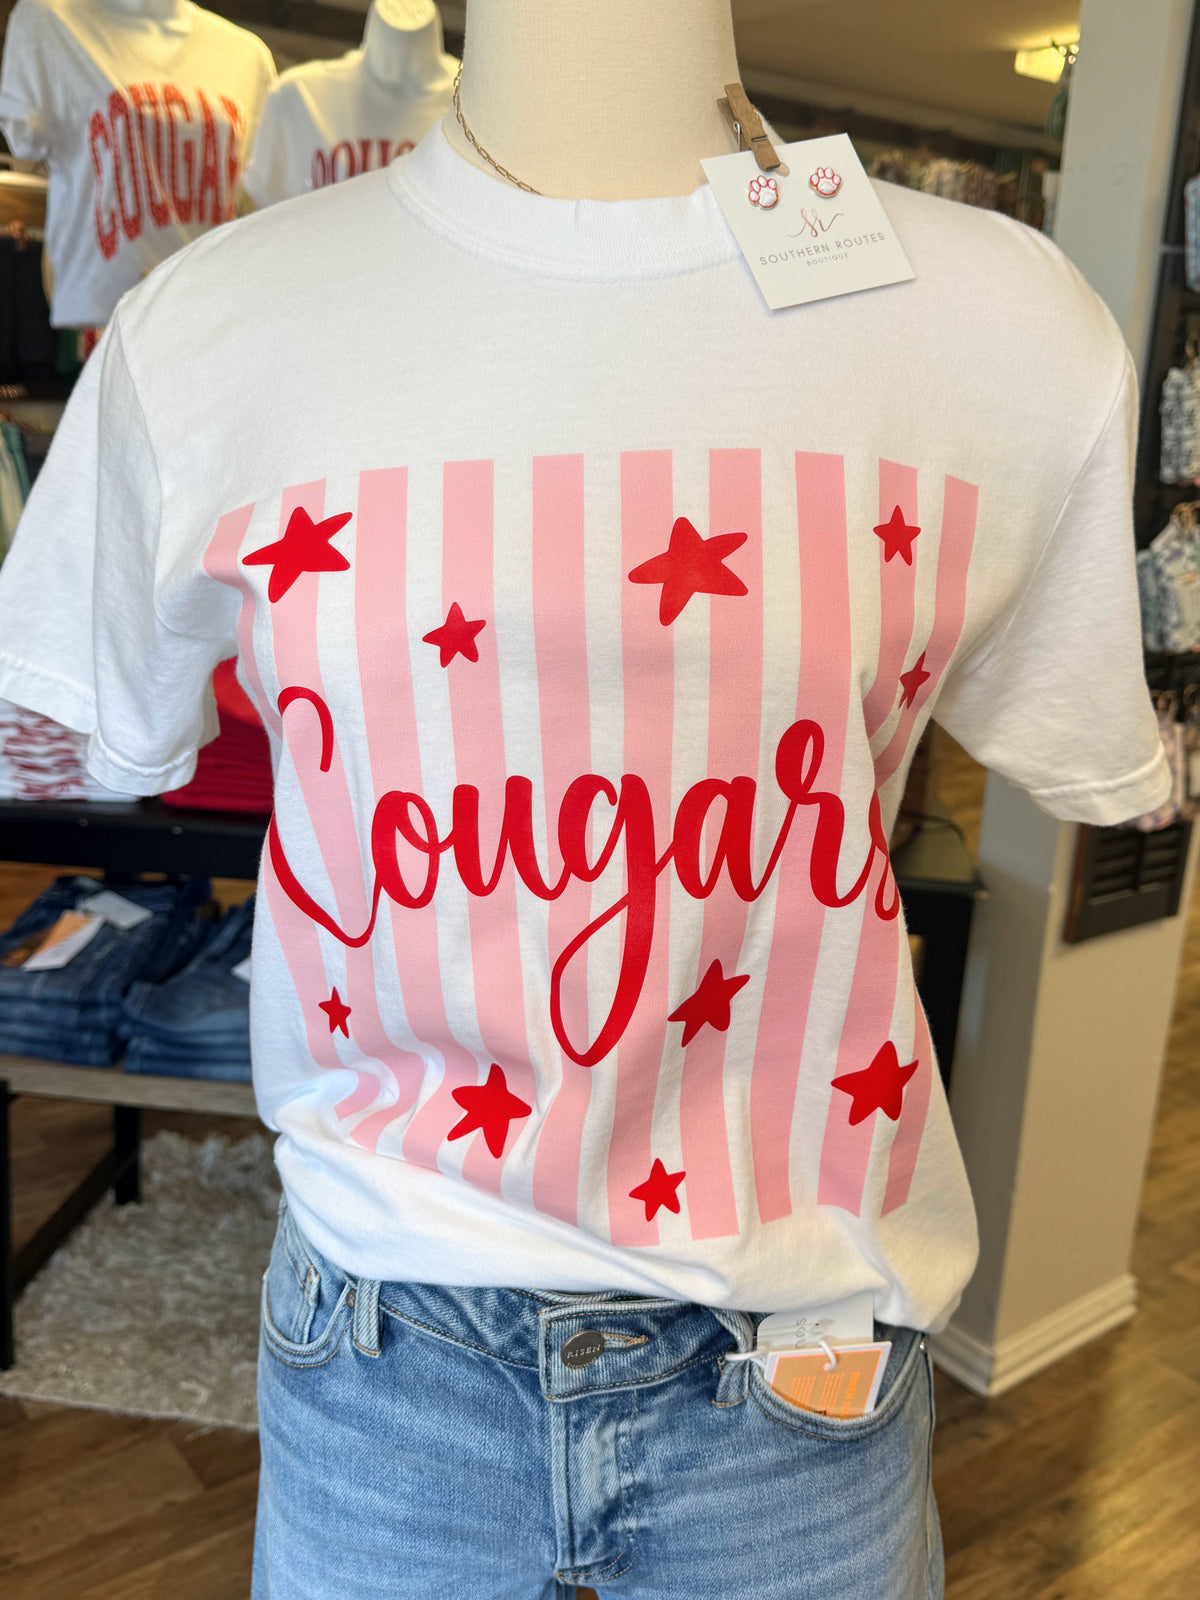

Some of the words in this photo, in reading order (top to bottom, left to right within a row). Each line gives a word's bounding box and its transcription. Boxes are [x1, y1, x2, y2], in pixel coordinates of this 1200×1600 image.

[759, 243, 830, 266] SOUTHERN
[835, 232, 885, 250] ROUTES
[806, 252, 849, 266] BOUTIQUE
[268, 686, 900, 1067] Cougars
[566, 1343, 601, 1359] RISEN
